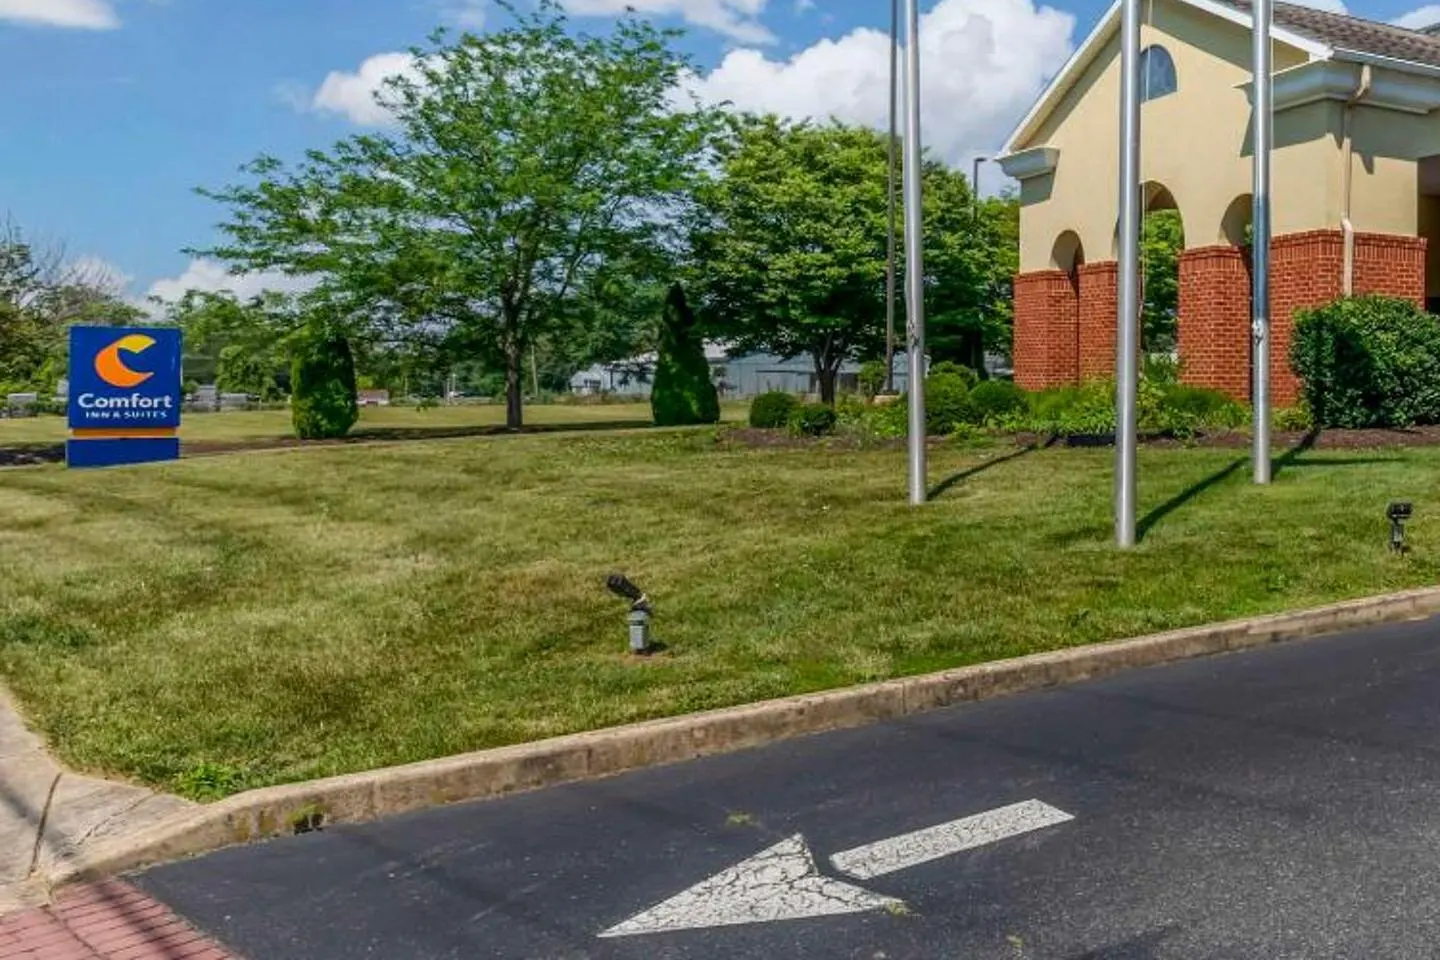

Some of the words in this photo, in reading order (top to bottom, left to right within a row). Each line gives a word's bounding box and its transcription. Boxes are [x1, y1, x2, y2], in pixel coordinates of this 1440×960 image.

[77, 392, 173, 409] Comfort
[86, 410, 110, 419] INN
[124, 410, 168, 419] SUITES
